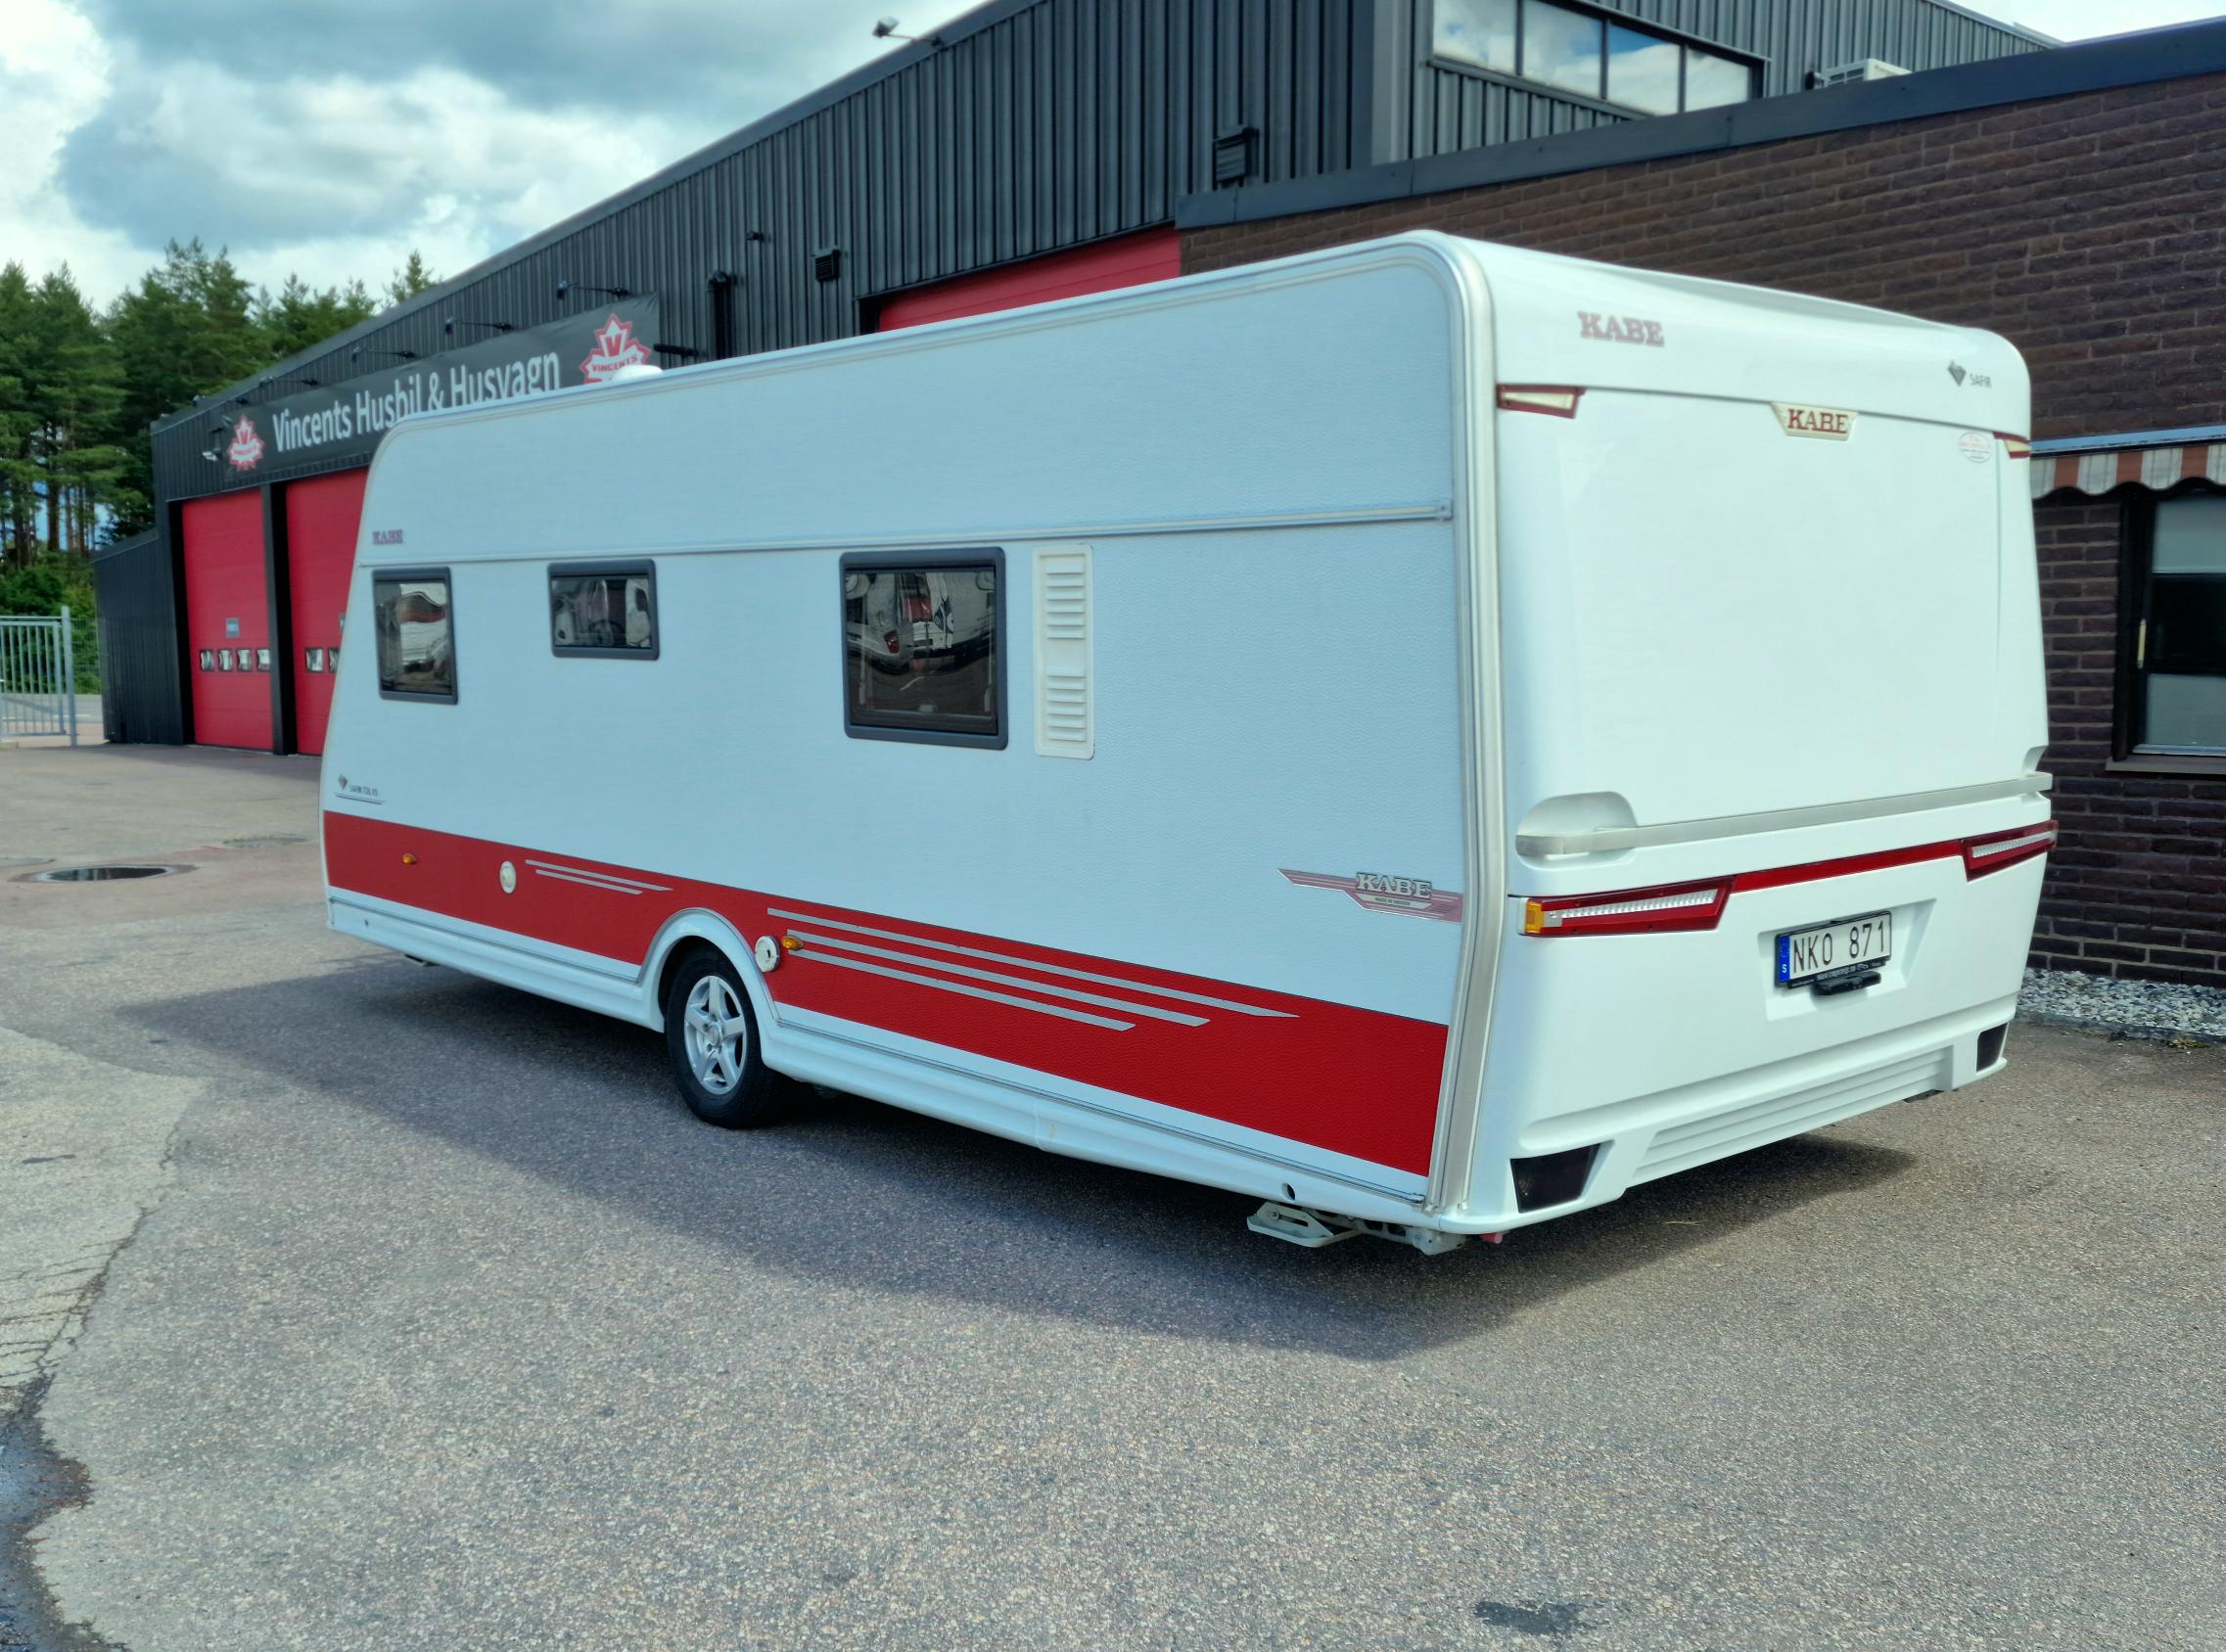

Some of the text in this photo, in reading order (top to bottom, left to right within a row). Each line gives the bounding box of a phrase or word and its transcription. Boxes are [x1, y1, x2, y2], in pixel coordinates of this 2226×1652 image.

[1577, 310, 1665, 347] KABE
[272, 352, 560, 452] Vincents Husbil & Husvagn
[1787, 408, 1848, 435] KABE
[372, 529, 403, 545] KABE
[1355, 871, 1433, 899] KABE
[1793, 933, 1832, 973] NKO
[1849, 921, 1884, 959] 871
